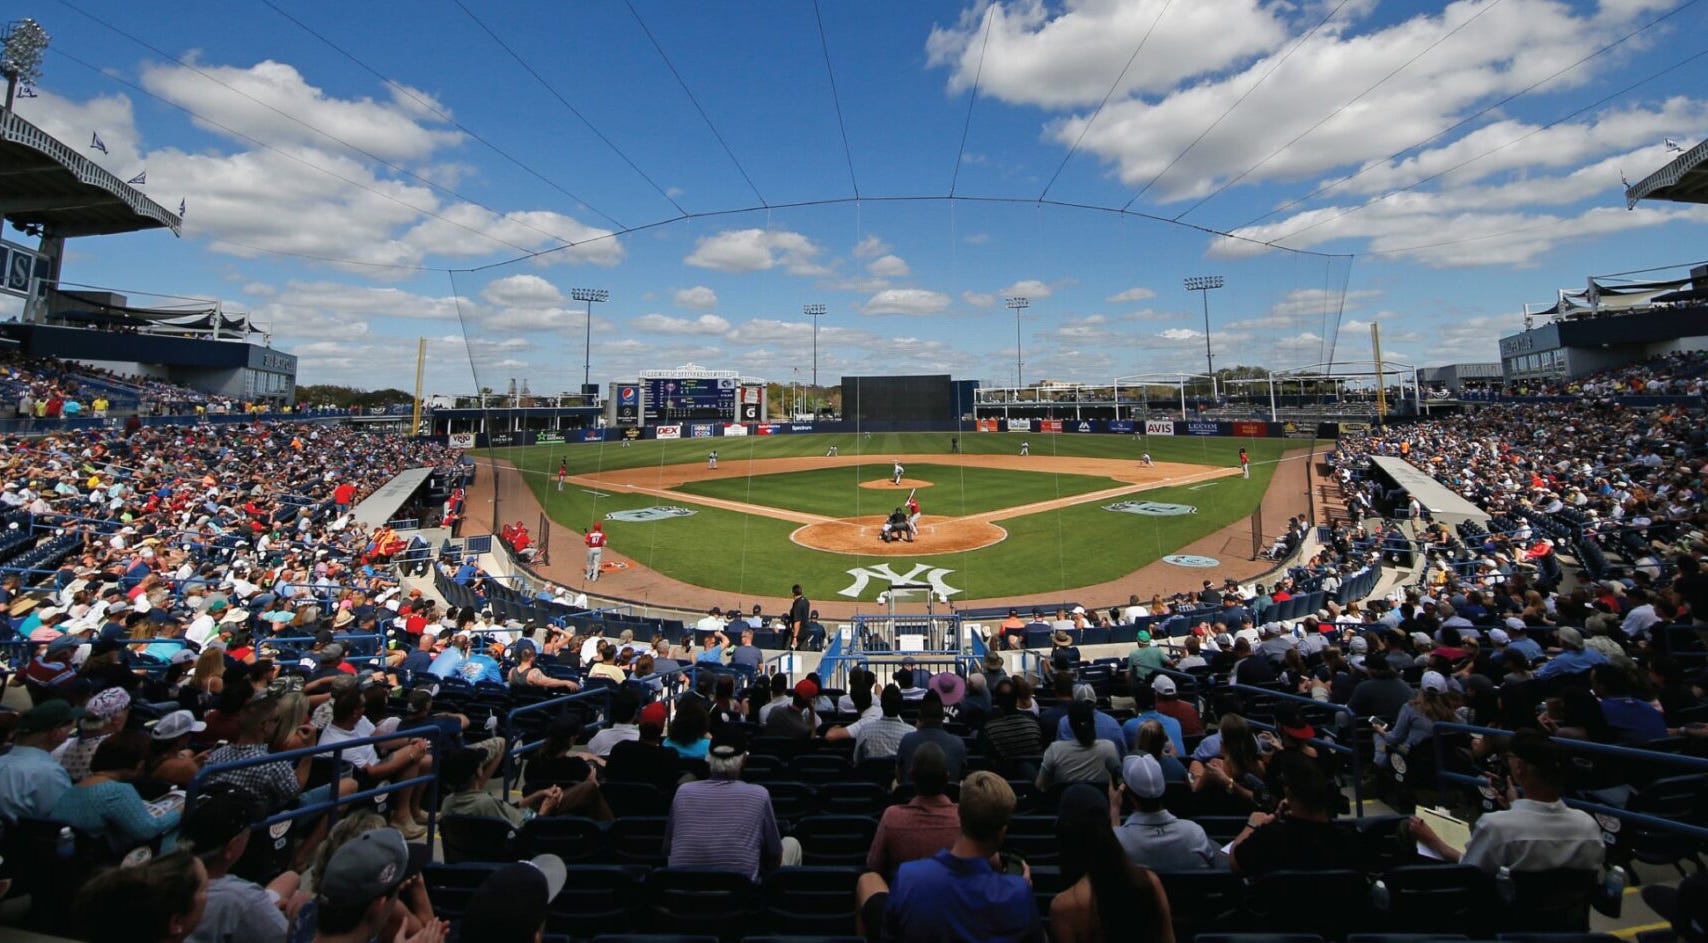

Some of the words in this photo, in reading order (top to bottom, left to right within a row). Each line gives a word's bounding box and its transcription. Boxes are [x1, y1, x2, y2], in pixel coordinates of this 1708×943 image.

[13, 256, 27, 287] S
[746, 408, 755, 417] G
[1147, 424, 1172, 433] AVIS
[836, 563, 964, 598] NY
